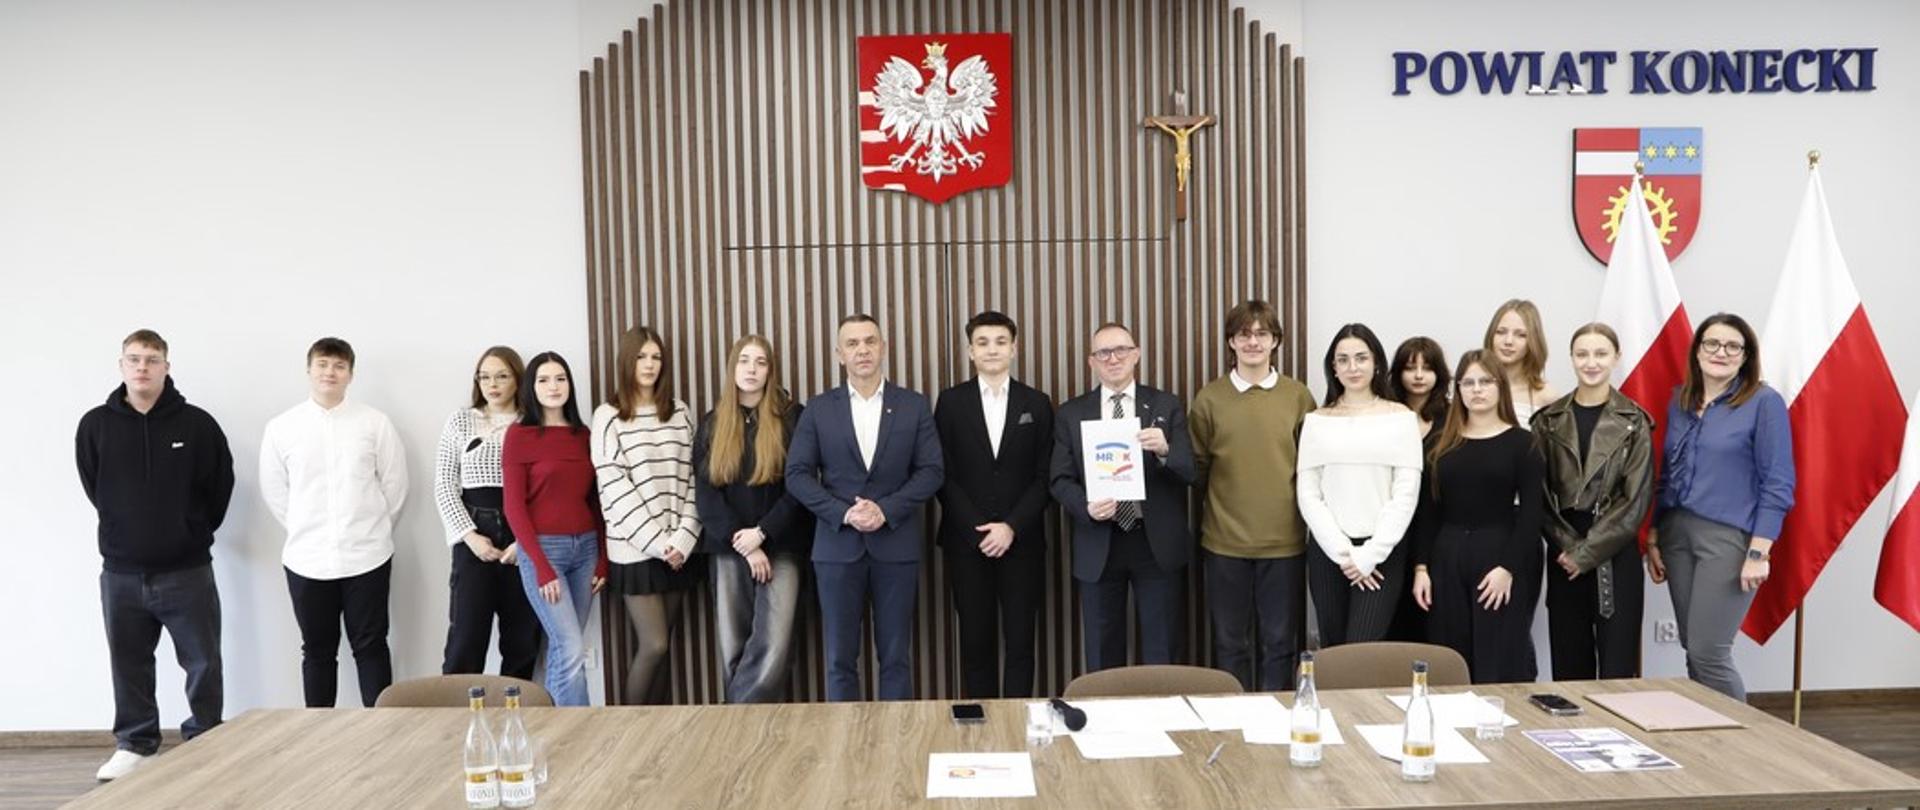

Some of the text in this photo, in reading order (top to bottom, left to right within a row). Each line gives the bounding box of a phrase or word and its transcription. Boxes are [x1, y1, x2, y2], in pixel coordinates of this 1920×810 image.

[1392, 47, 1878, 96] POWIAT KONECKI
[1095, 452, 1131, 462] MRK
